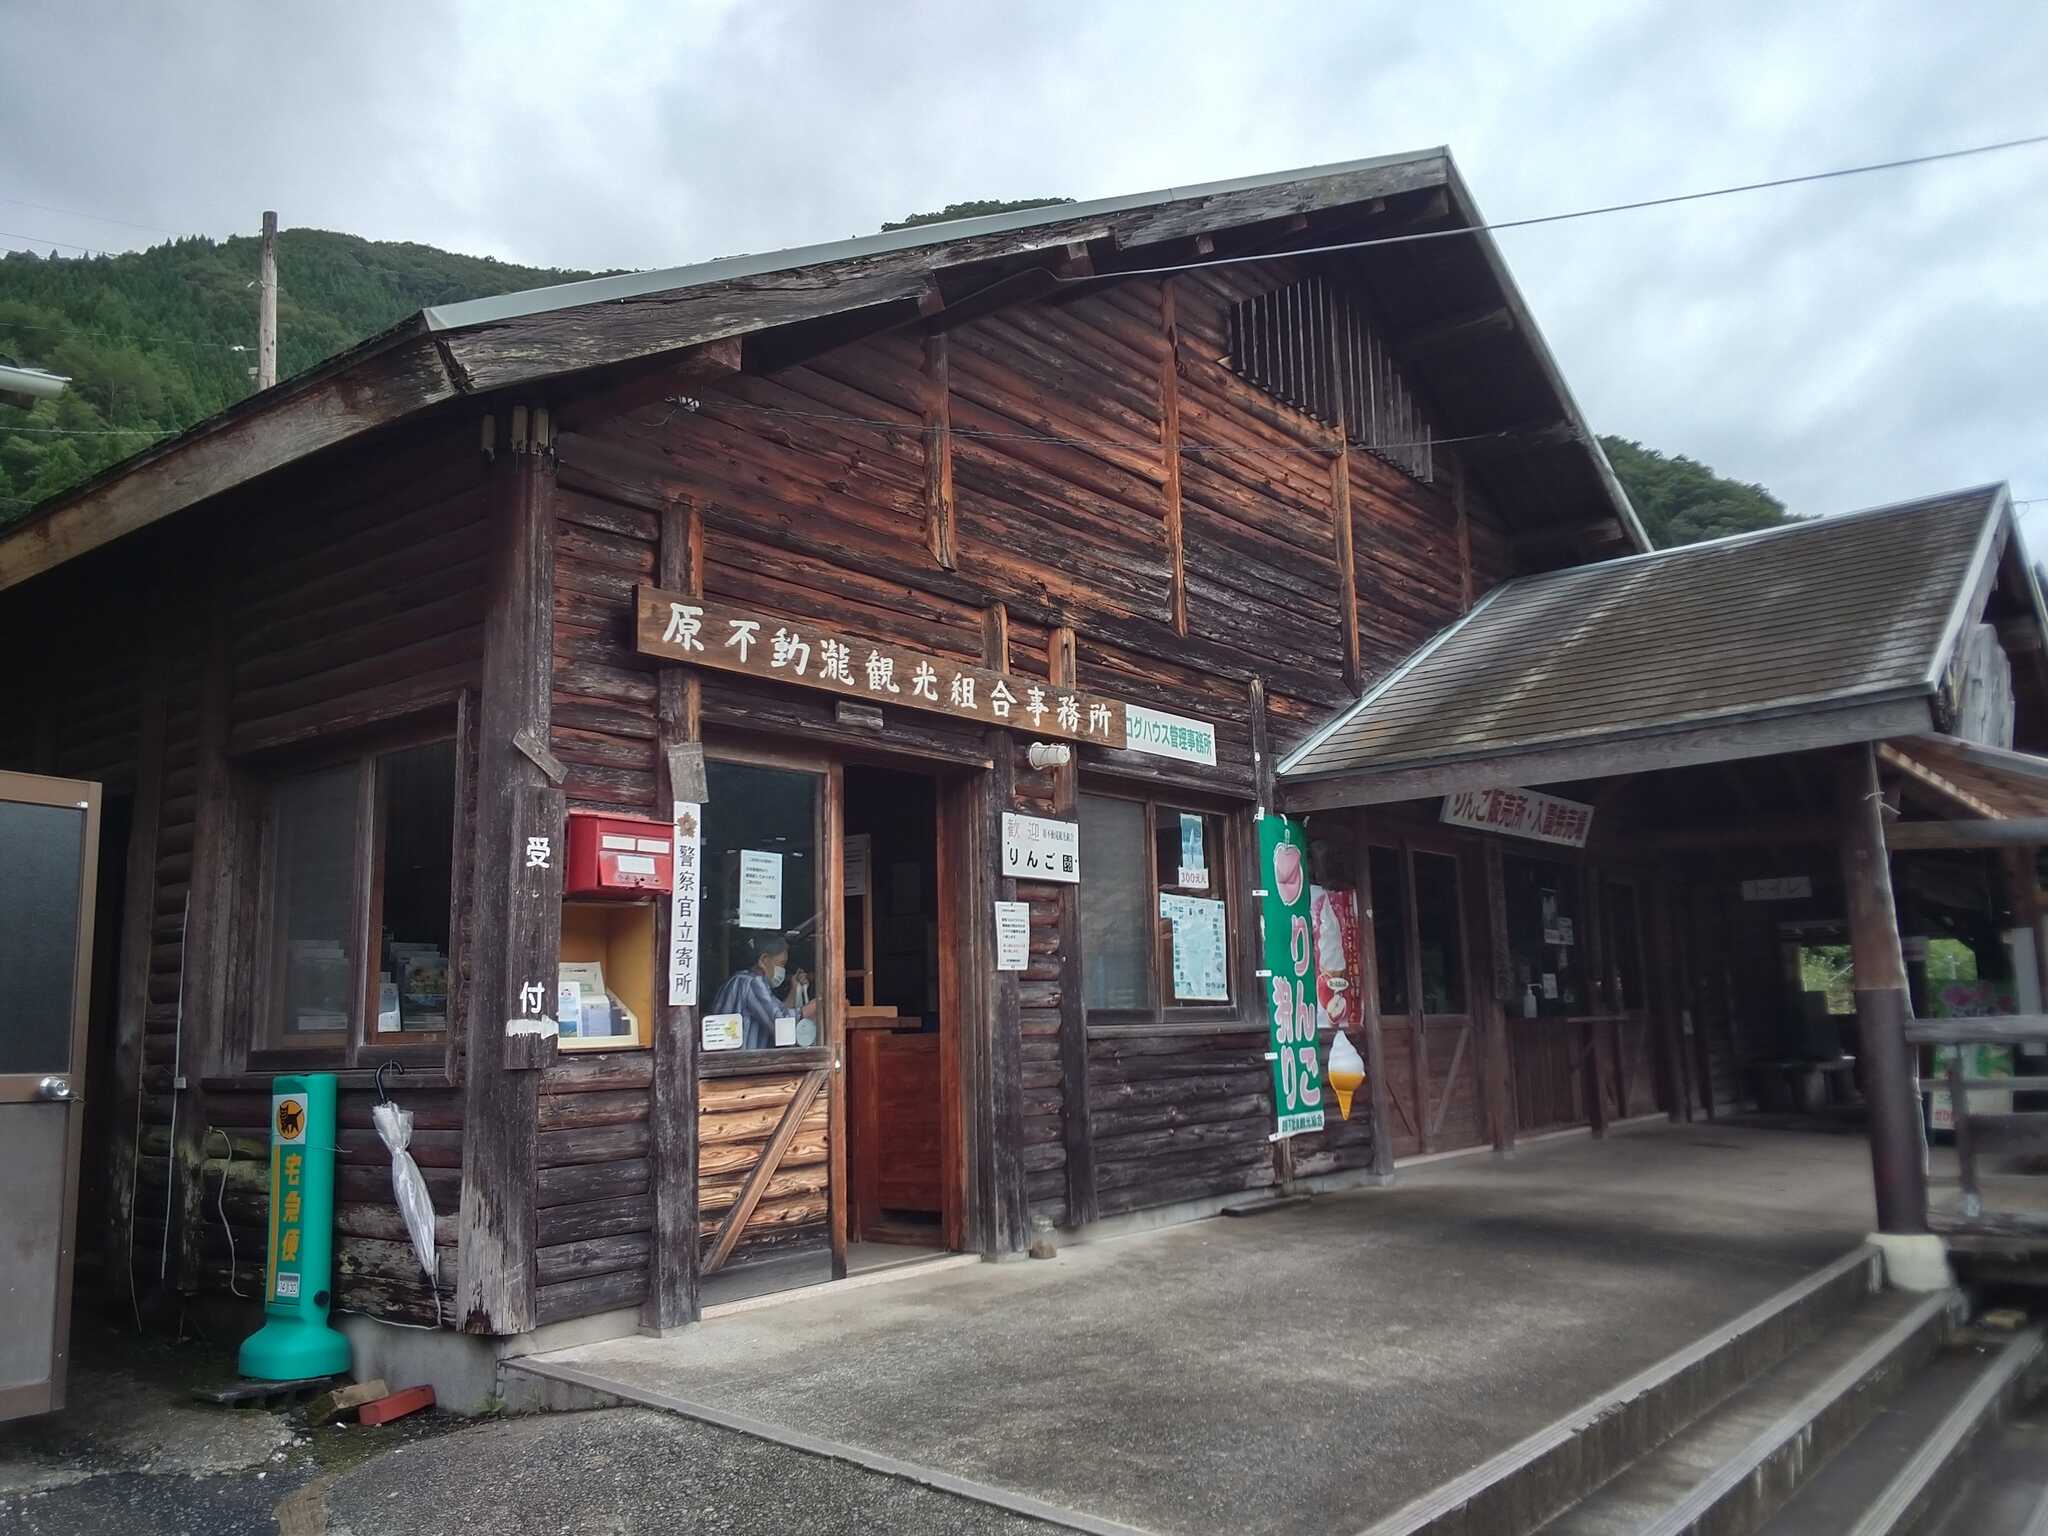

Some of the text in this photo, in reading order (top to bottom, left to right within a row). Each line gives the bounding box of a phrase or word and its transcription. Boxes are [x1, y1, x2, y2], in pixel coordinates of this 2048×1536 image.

[662, 602, 1113, 737] 原不動瀧観光組合事務所
[519, 836, 551, 1014] 受付
[674, 844, 697, 994] 警察官立寄所
[1009, 847, 1073, 873] りんご園
[1290, 914, 1321, 1107] りんご
[282, 1153, 302, 1262] 宅急便
